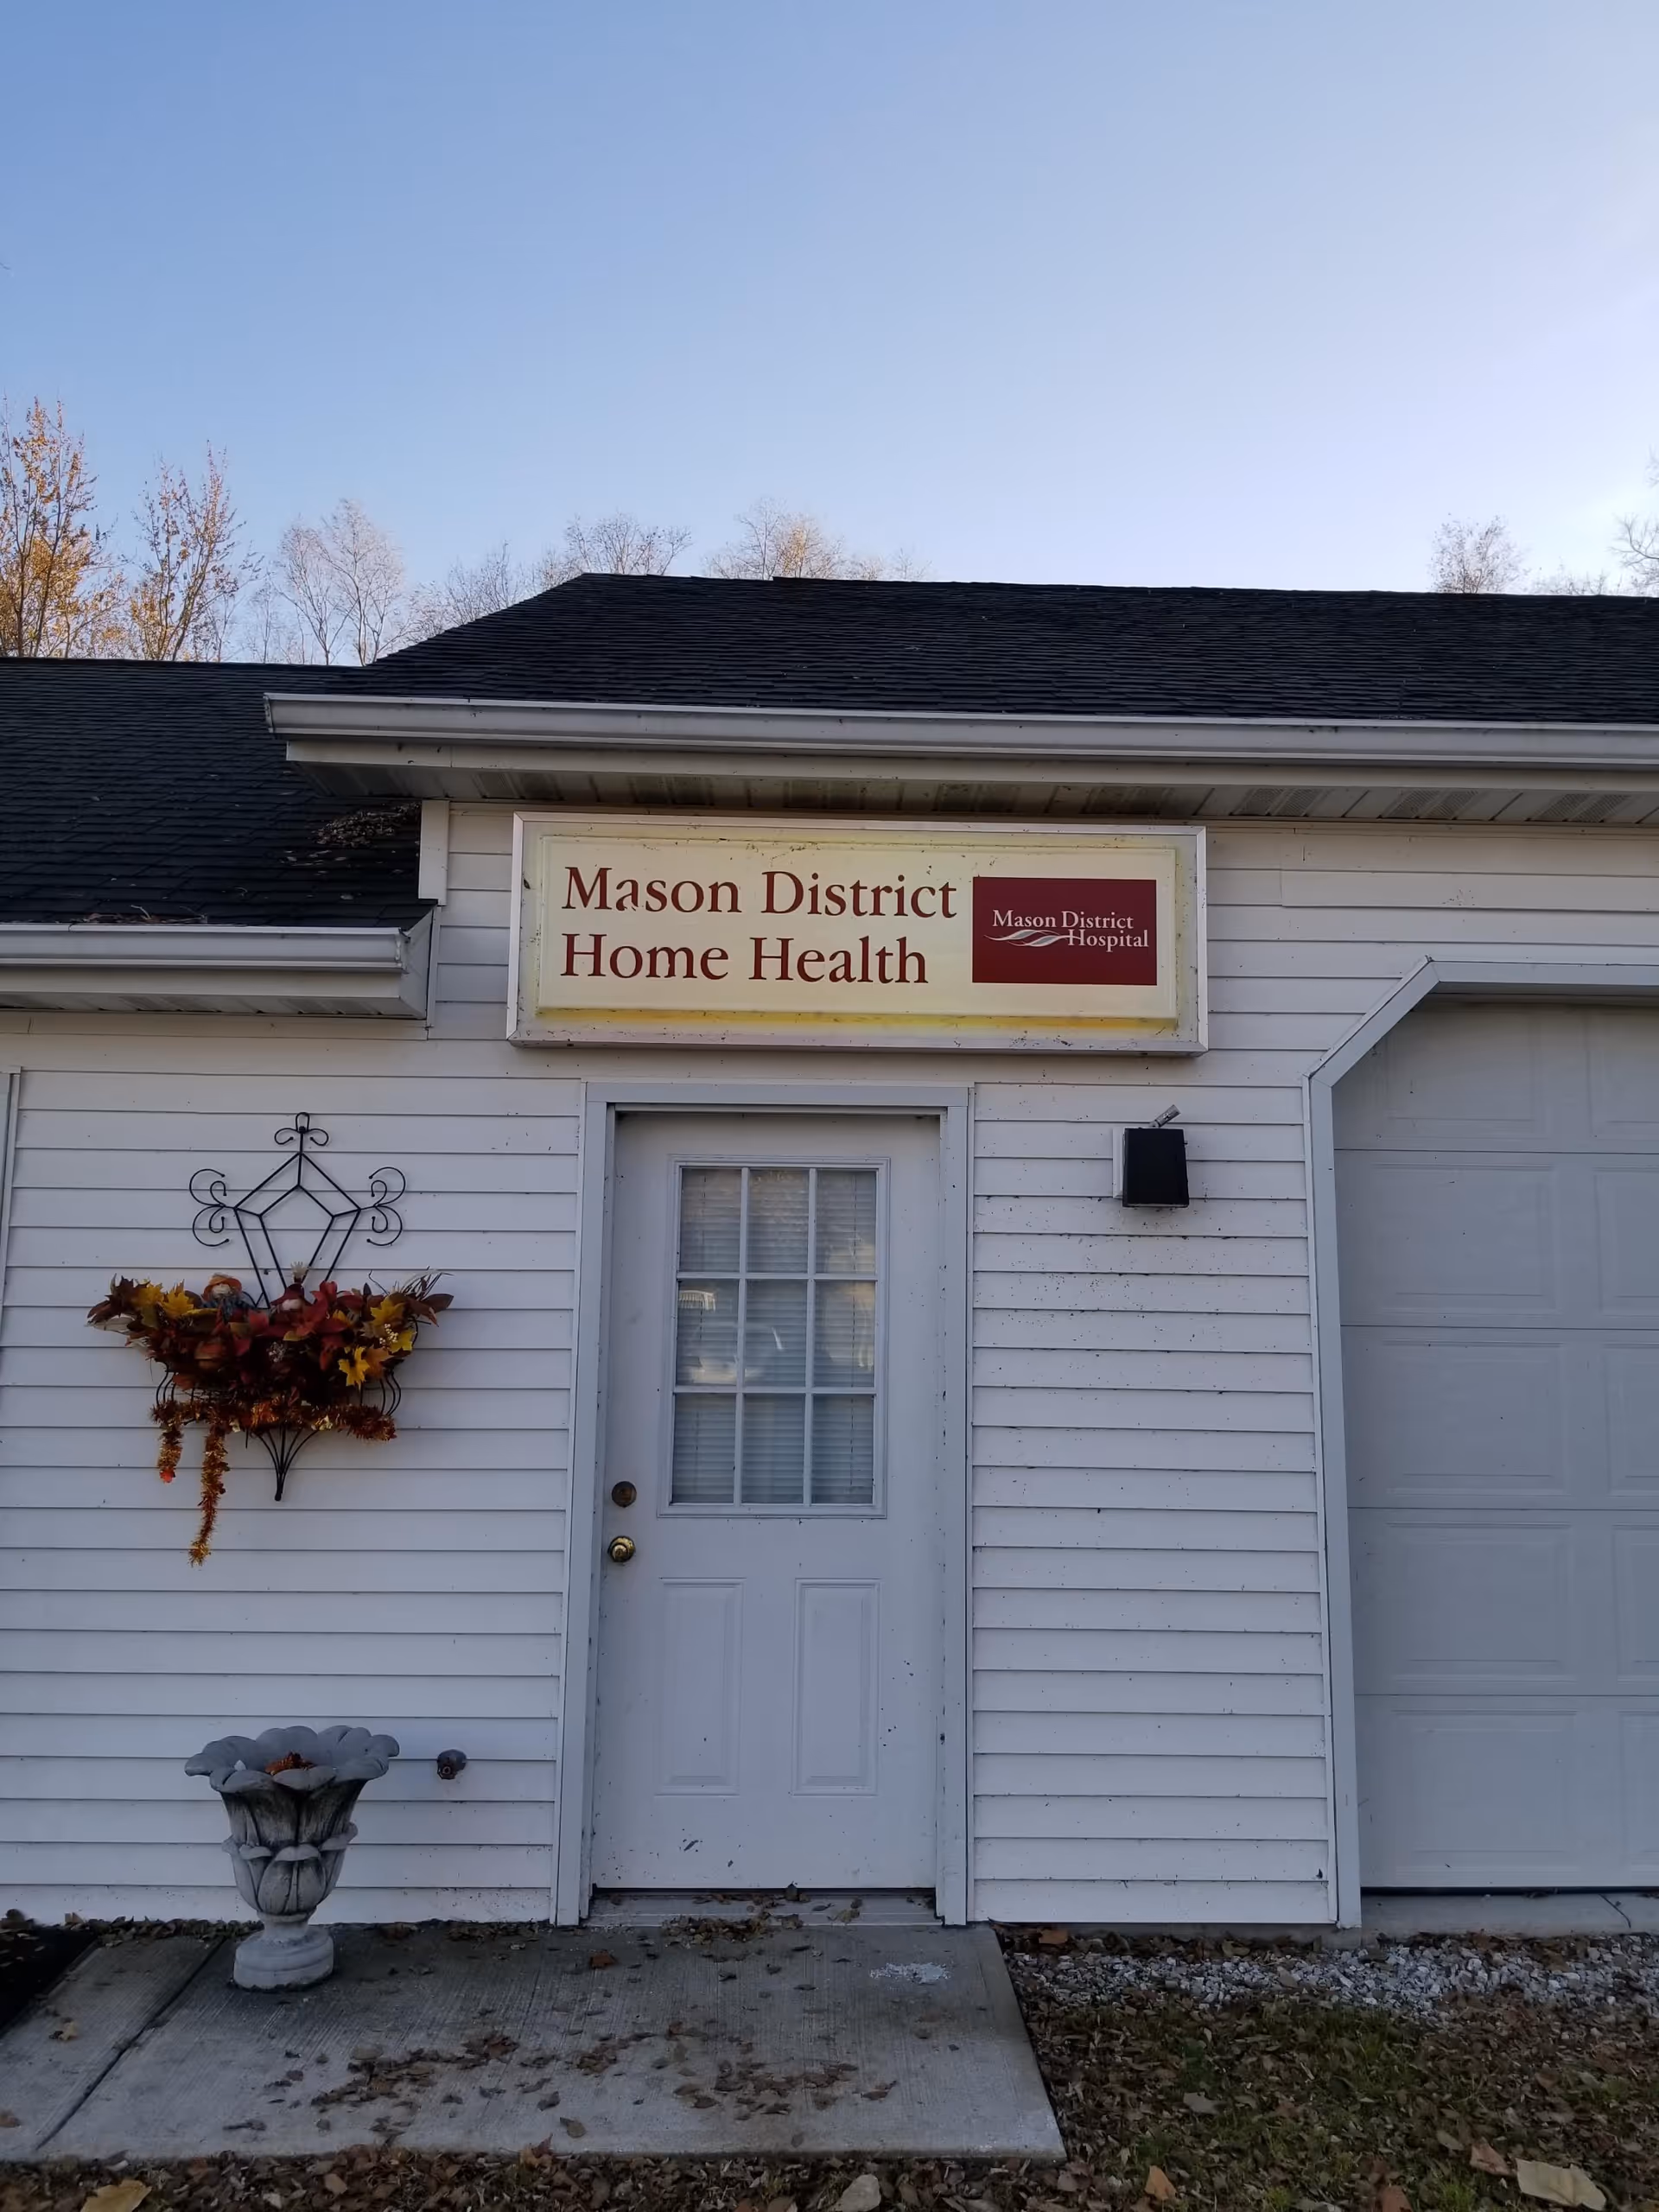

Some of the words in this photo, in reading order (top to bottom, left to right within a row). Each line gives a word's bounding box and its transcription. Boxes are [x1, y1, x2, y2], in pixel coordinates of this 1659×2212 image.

[562, 866, 741, 914] Mason
[761, 870, 957, 918] District
[992, 909, 1058, 928] Mason
[1061, 911, 1134, 930] District
[560, 932, 729, 981] Home
[749, 936, 928, 985] Health
[1067, 929, 1149, 952] Hospital
